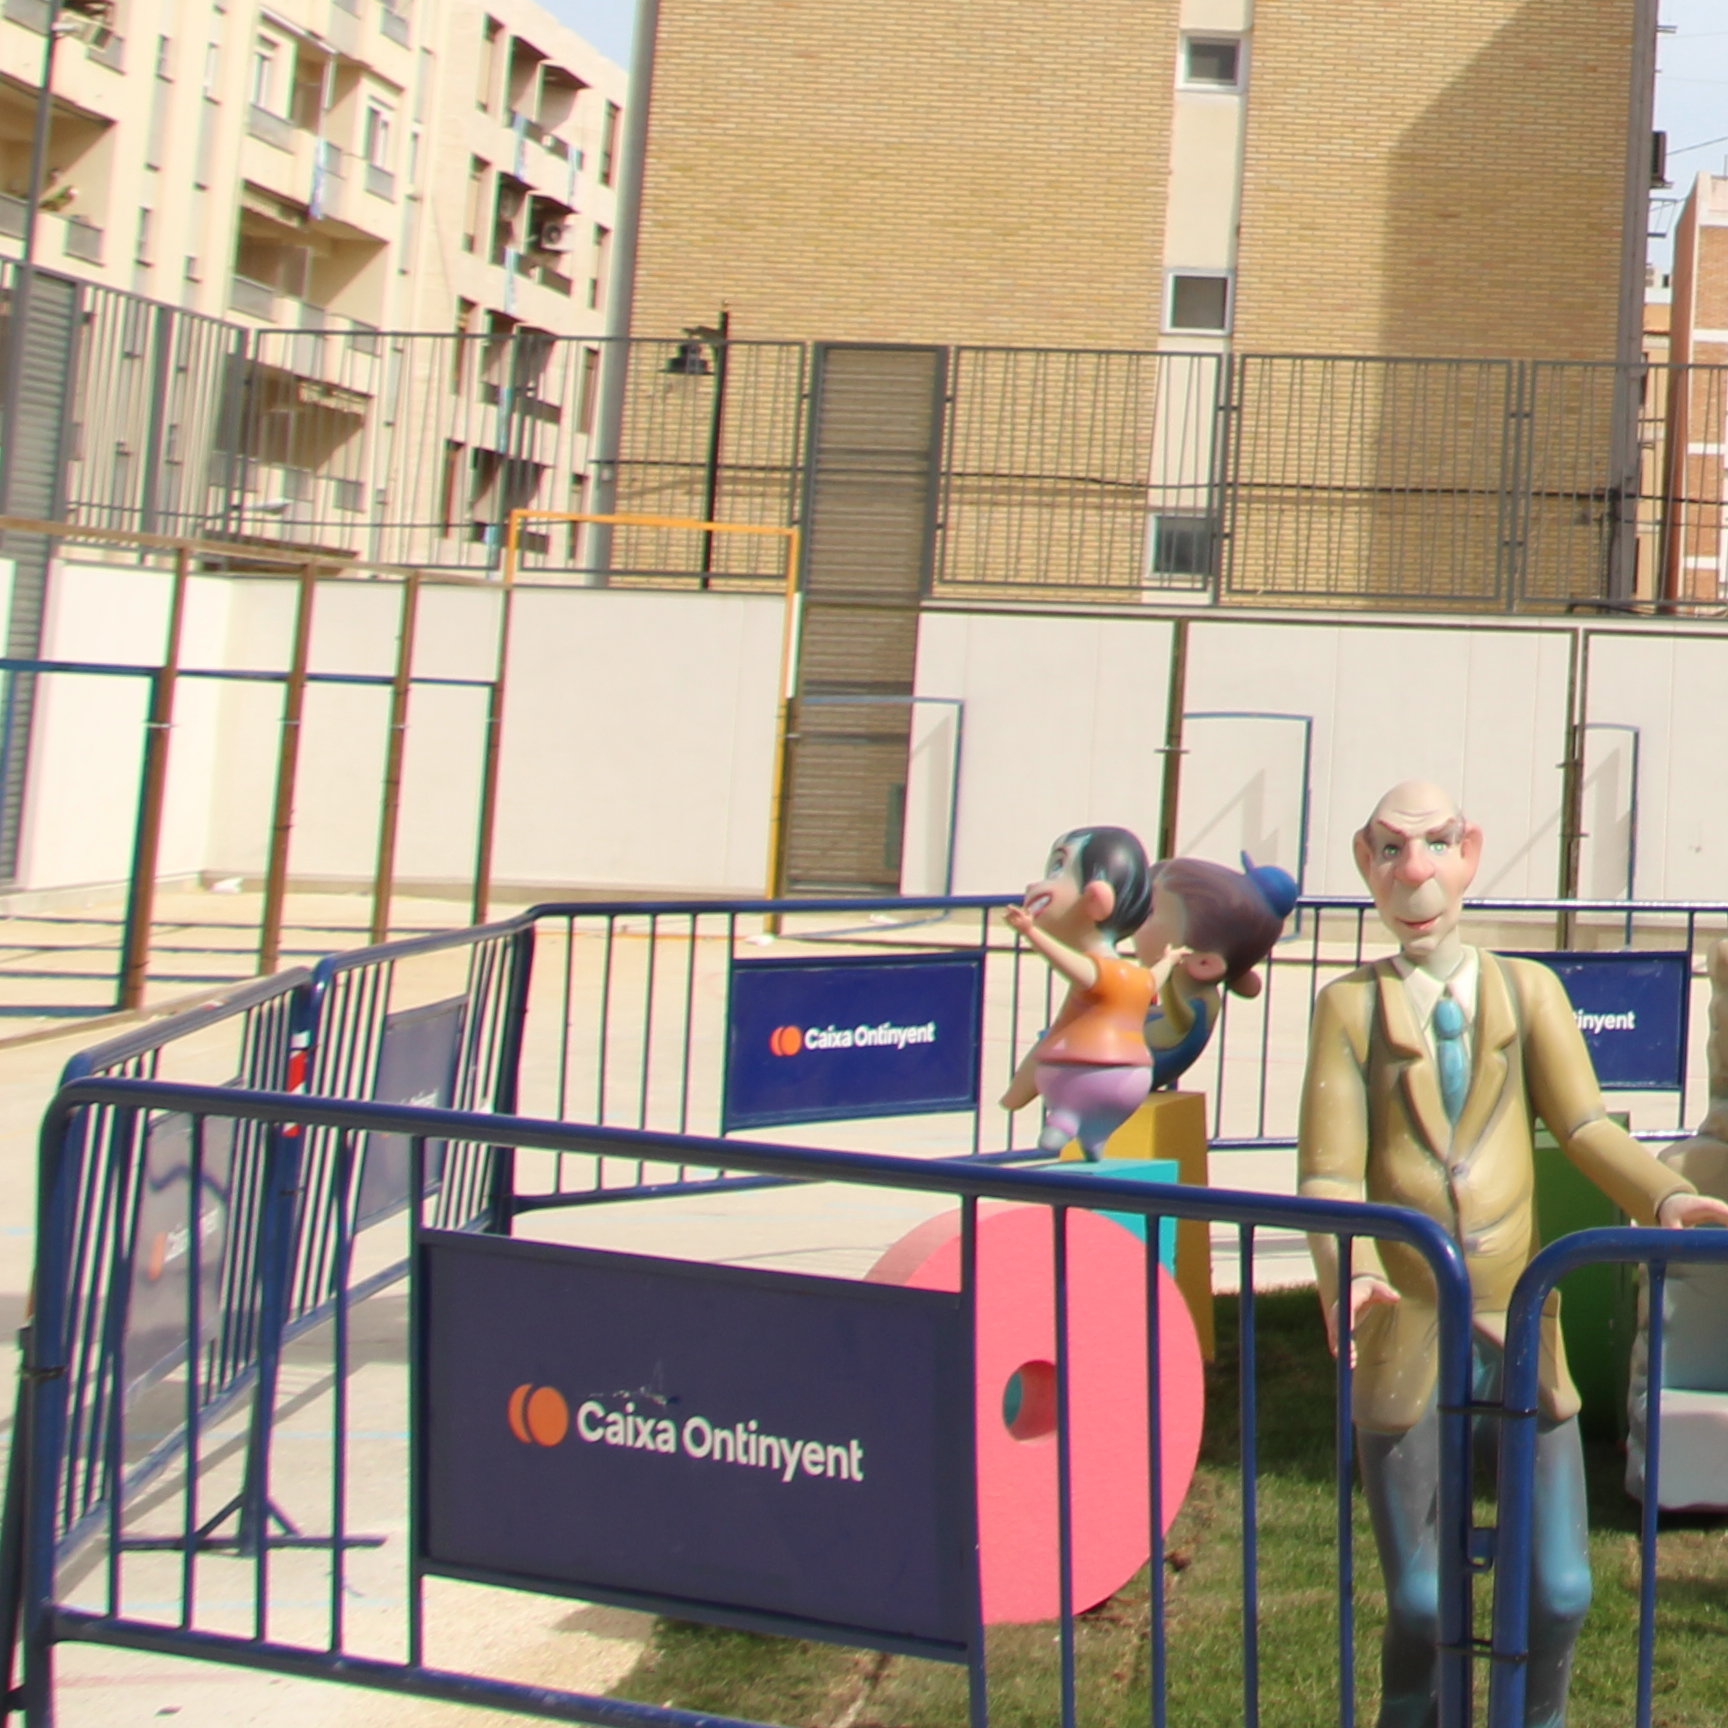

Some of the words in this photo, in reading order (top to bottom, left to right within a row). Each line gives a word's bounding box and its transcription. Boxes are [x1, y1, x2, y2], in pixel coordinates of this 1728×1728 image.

[804, 1025, 852, 1049] Caixa
[854, 1021, 936, 1049] Ontinyent
[1573, 1009, 1635, 1034] inyent
[577, 1401, 676, 1454] Caixa
[682, 1416, 864, 1483] Ontinyent
